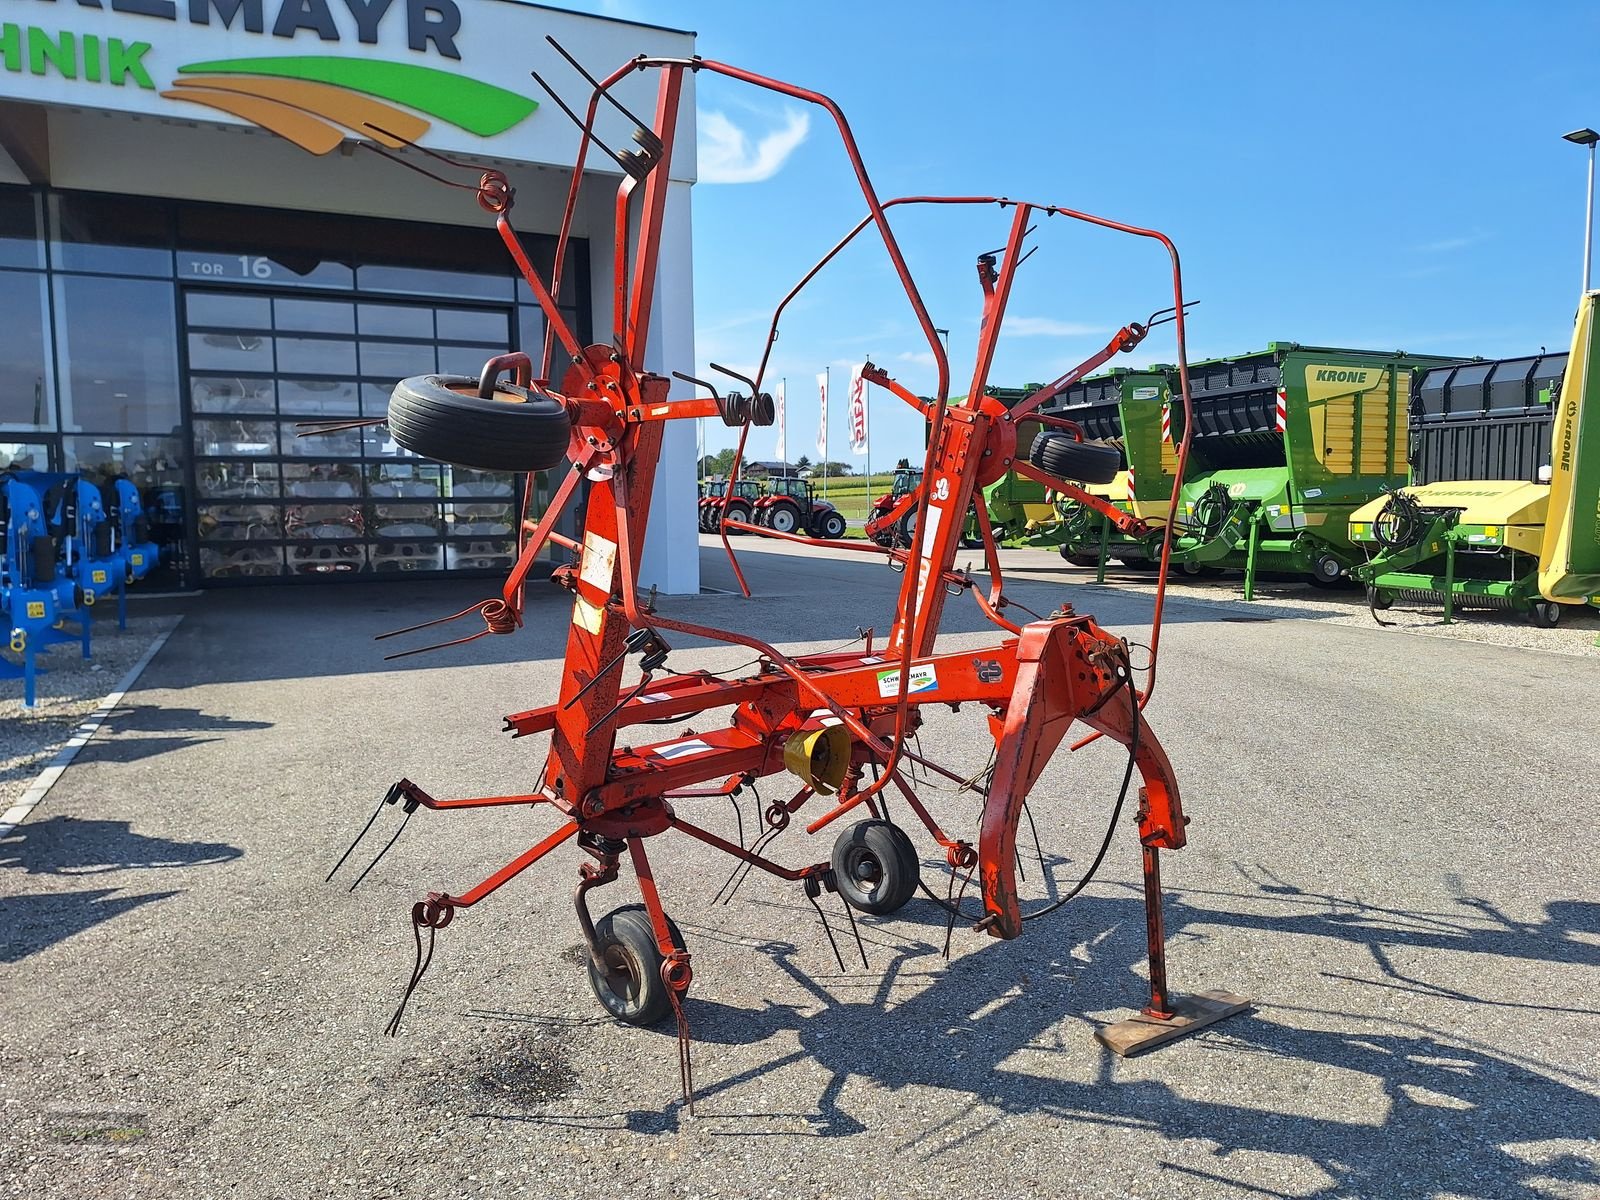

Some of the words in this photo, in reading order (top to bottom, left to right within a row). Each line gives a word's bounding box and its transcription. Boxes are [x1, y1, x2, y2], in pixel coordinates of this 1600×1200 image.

[77, 0, 462, 60] MAYR
[191, 262, 224, 275] TOR
[239, 255, 272, 279] 16
[1316, 369, 1367, 383] KRONE
[1560, 419, 1572, 473] KRONE
[883, 671, 928, 684] SCHWMAYR
